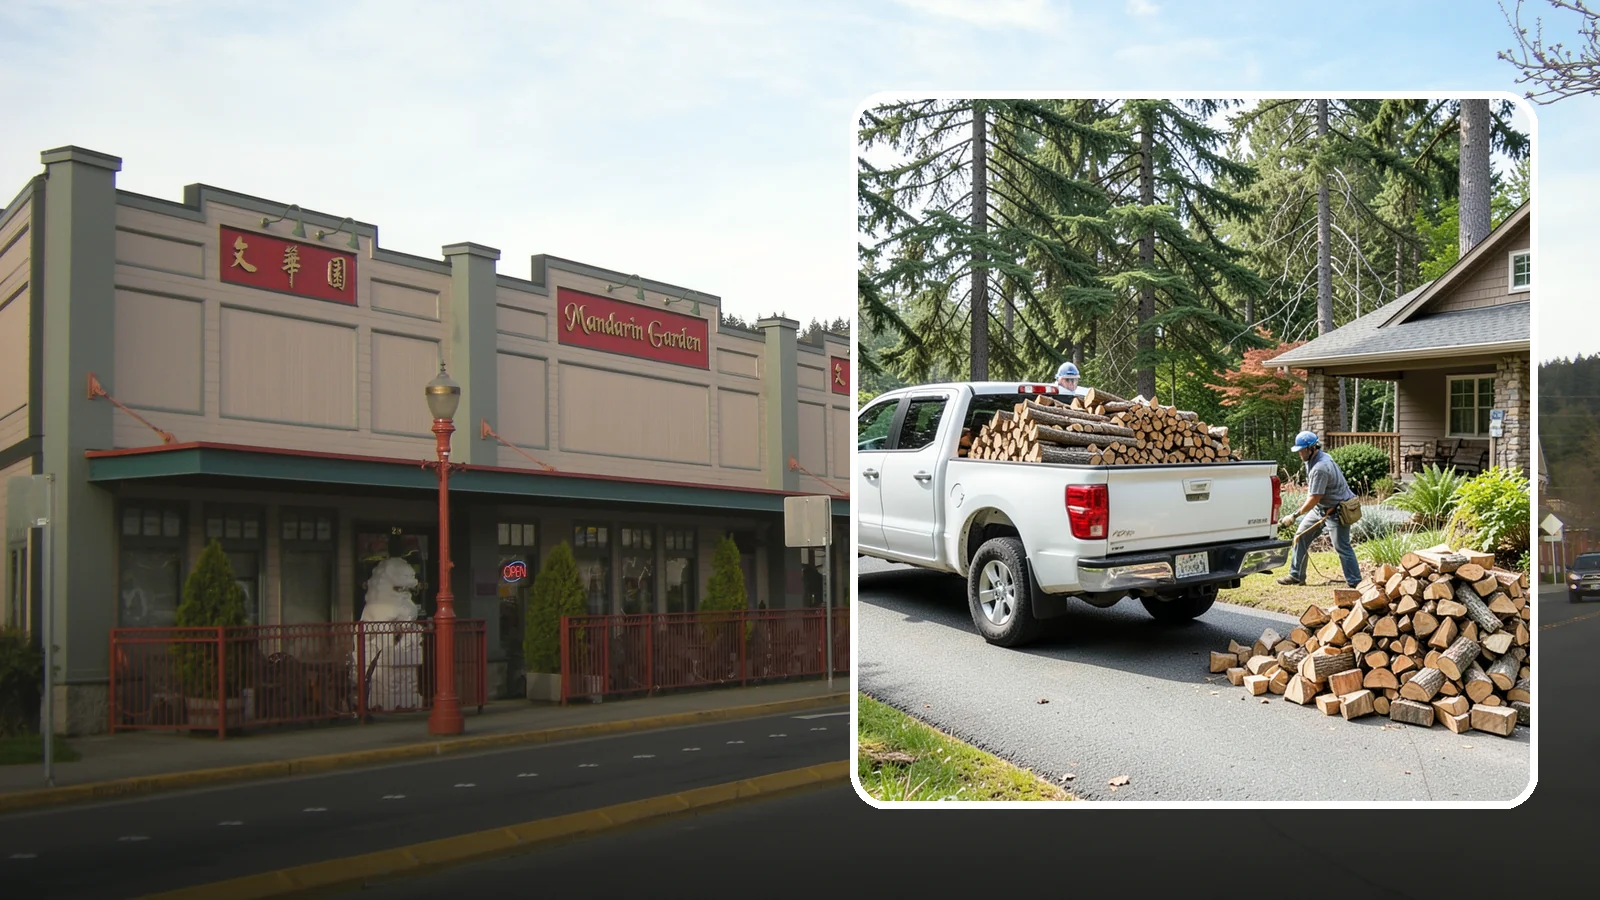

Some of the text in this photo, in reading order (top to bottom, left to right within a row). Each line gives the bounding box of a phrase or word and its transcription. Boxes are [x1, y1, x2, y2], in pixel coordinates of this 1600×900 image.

[231, 235, 346, 291] 文華園
[564, 302, 702, 352] Mandarin Garden
[503, 565, 527, 578] OPEN
